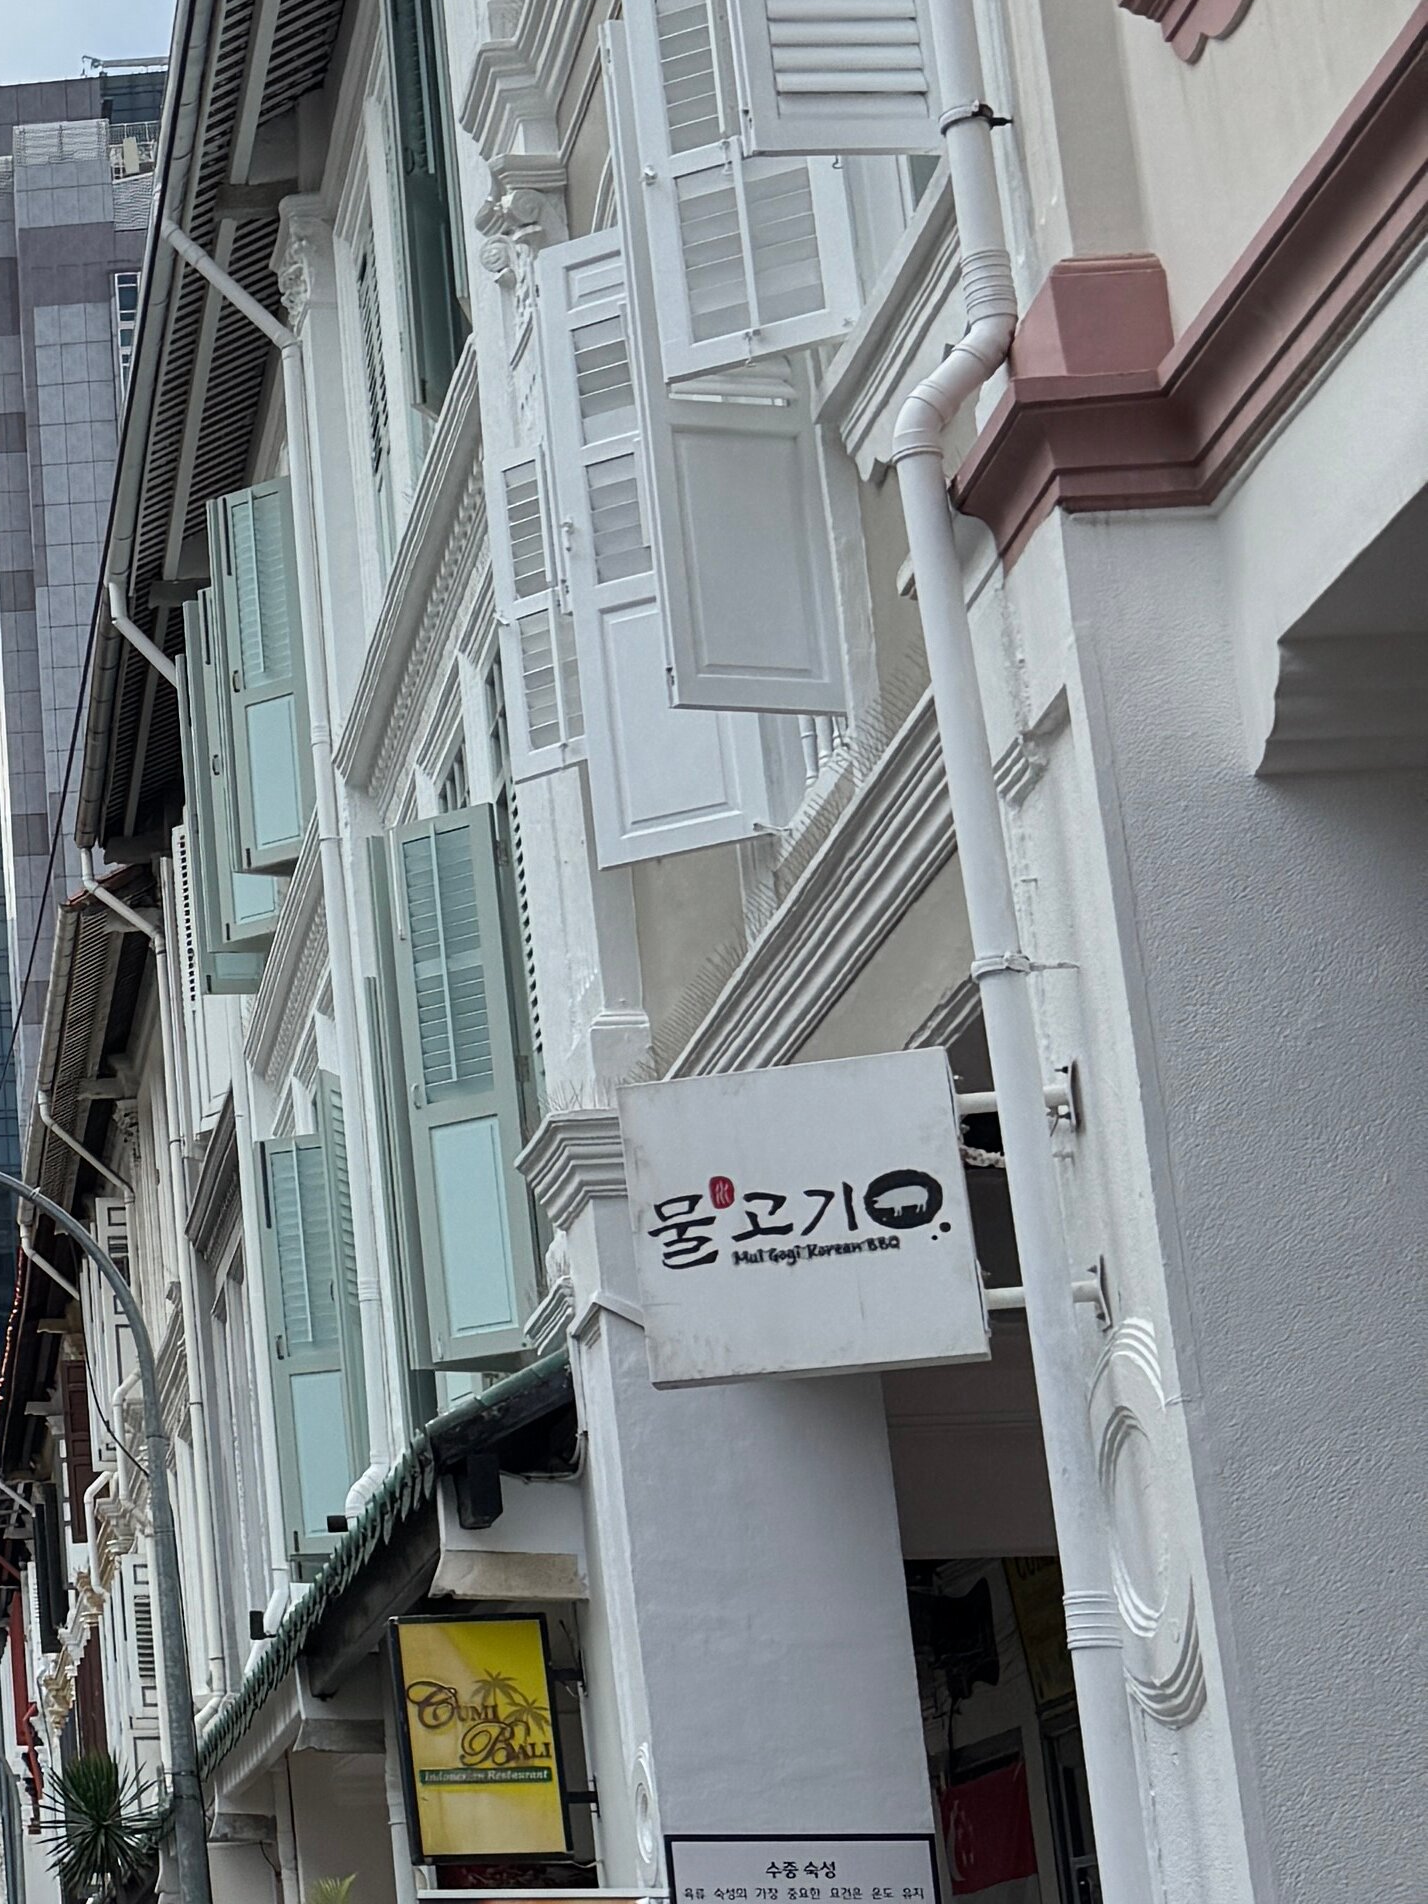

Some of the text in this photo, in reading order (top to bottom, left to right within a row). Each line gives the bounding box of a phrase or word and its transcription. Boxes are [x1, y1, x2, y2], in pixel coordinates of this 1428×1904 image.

[648, 1182, 858, 1269] 물고기
[866, 1235, 901, 1251] BBQ
[487, 1769, 549, 1781] Restaurant
[765, 1861, 836, 1879] 수중 숙성
[871, 1887, 894, 1900] 온도
[902, 1887, 924, 1900] 유지
